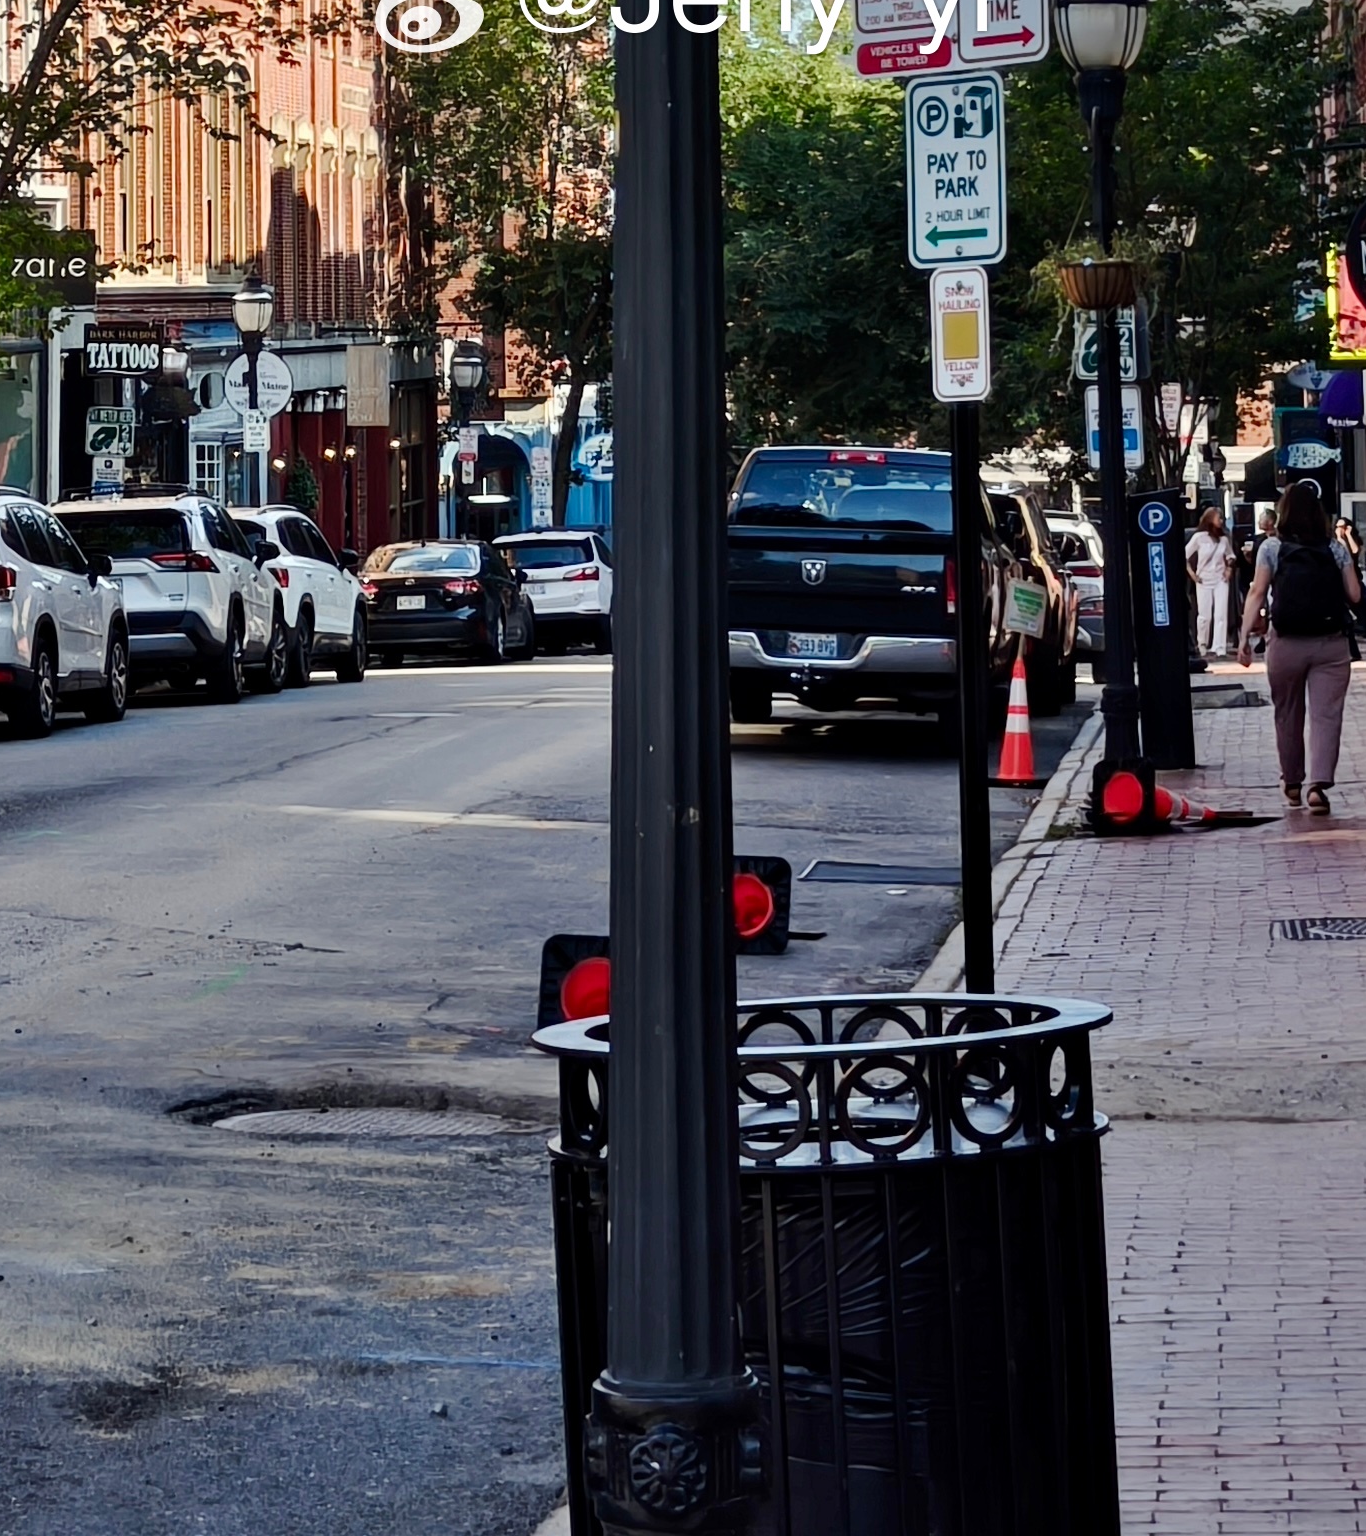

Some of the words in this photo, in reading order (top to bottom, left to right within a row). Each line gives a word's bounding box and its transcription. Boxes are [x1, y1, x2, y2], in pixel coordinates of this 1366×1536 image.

[892, 2, 914, 12] THRU
[883, 14, 894, 23] AM
[870, 43, 914, 56] VEHICLES
[880, 58, 893, 68] BE
[896, 55, 928, 67] TOWED
[927, 151, 959, 174] PAY
[966, 149, 986, 171] TO
[935, 176, 979, 200] PARK
[925, 212, 932, 224] 2
[936, 209, 963, 222] HOUR
[967, 207, 990, 220] LIMIT
[944, 285, 974, 298] SNOW
[938, 298, 981, 312] HAULING
[89, 330, 115, 339] DARK
[119, 330, 157, 339] HARBOR
[1119, 327, 1130, 346] 2
[87, 342, 160, 370] TATTOOS
[944, 361, 980, 372] YELLOW
[950, 373, 974, 384] ZONE
[1148, 509, 1164, 530] P
[1151, 545, 1162, 578] PAY
[1154, 581, 1167, 622] HERE
